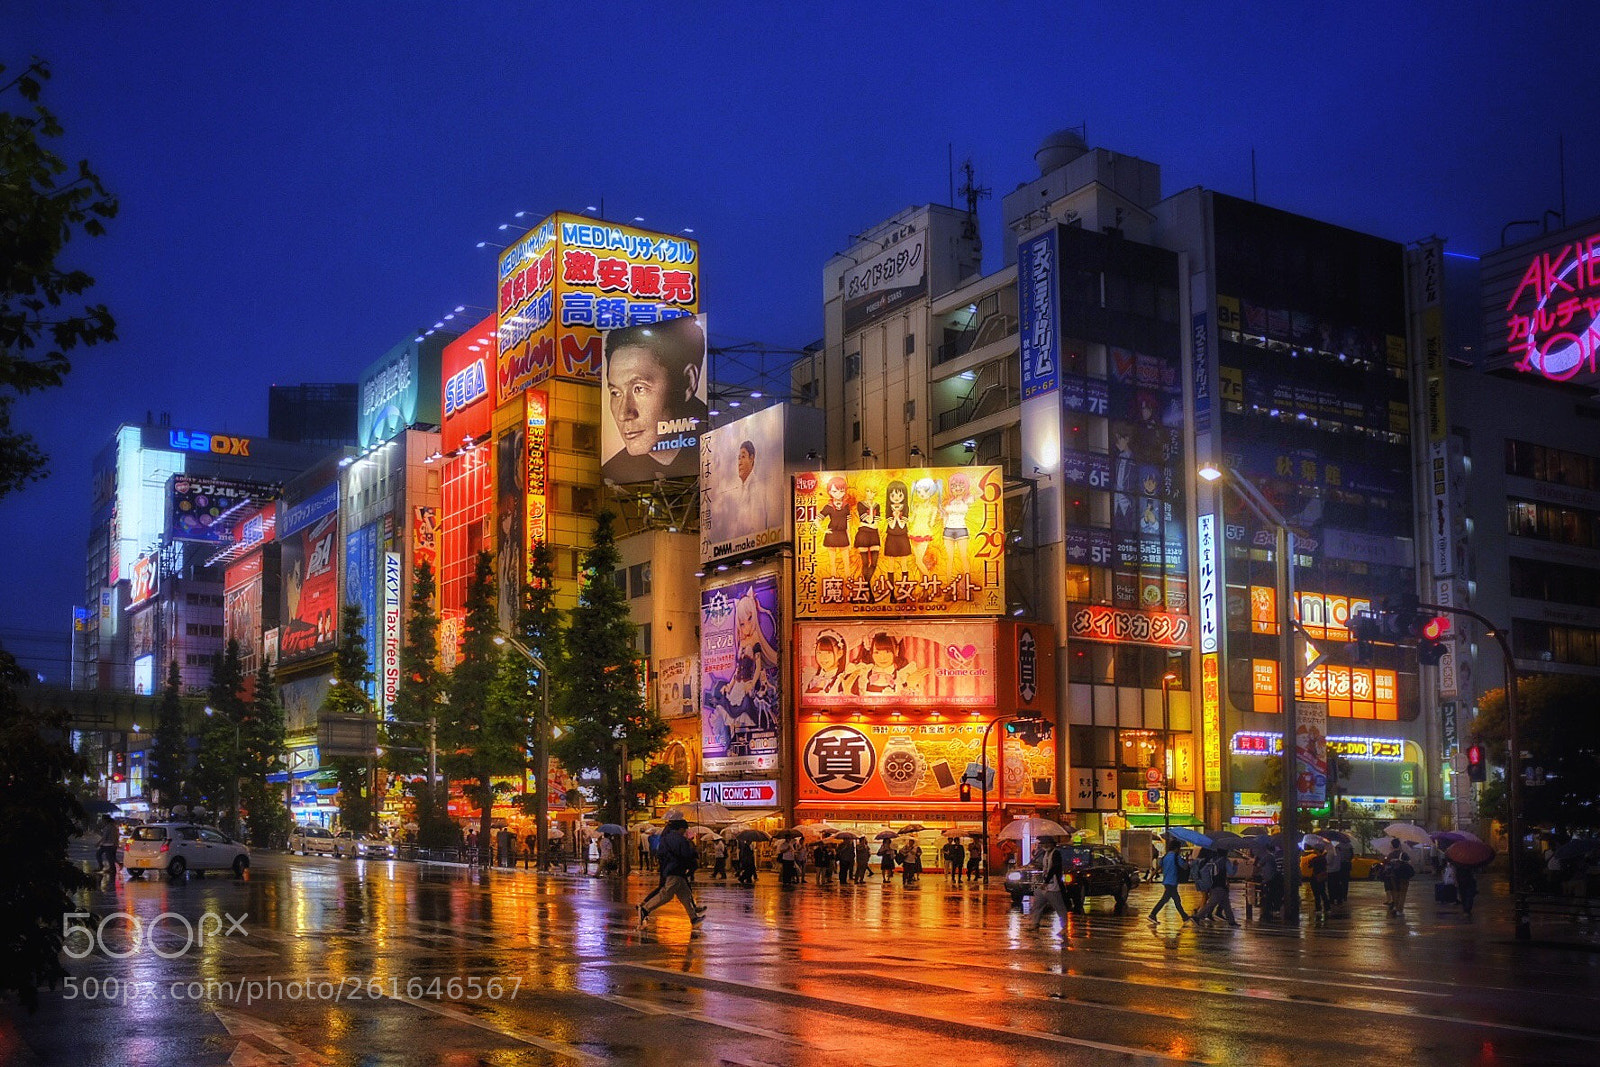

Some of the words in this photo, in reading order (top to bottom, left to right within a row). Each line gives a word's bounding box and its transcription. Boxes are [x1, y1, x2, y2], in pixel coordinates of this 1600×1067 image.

[562, 223, 695, 264] MEDIAリサイクル
[563, 251, 694, 304] 激安販売
[849, 243, 921, 297] メイドカジノ
[445, 359, 488, 417] SEGA
[1220, 378, 1241, 395] 7F
[1088, 396, 1109, 415] 7F
[1089, 470, 1110, 487] 6F
[1226, 524, 1245, 540] 5F
[1091, 547, 1111, 563] 5F
[387, 555, 399, 596] AKKY
[820, 572, 983, 605] 魔法少女サイト
[1072, 608, 1189, 643] メイドカジノ
[387, 608, 399, 666] Tax-free
[1255, 682, 1273, 691] Free
[1257, 674, 1271, 682] Tax
[1304, 672, 1369, 698] あみあみ
[1372, 742, 1400, 756] アニメ
[702, 784, 721, 803] ZIN
[723, 788, 748, 800] COMIC
[749, 788, 761, 799] ZIN
[1401, 804, 1418, 812] 1600
